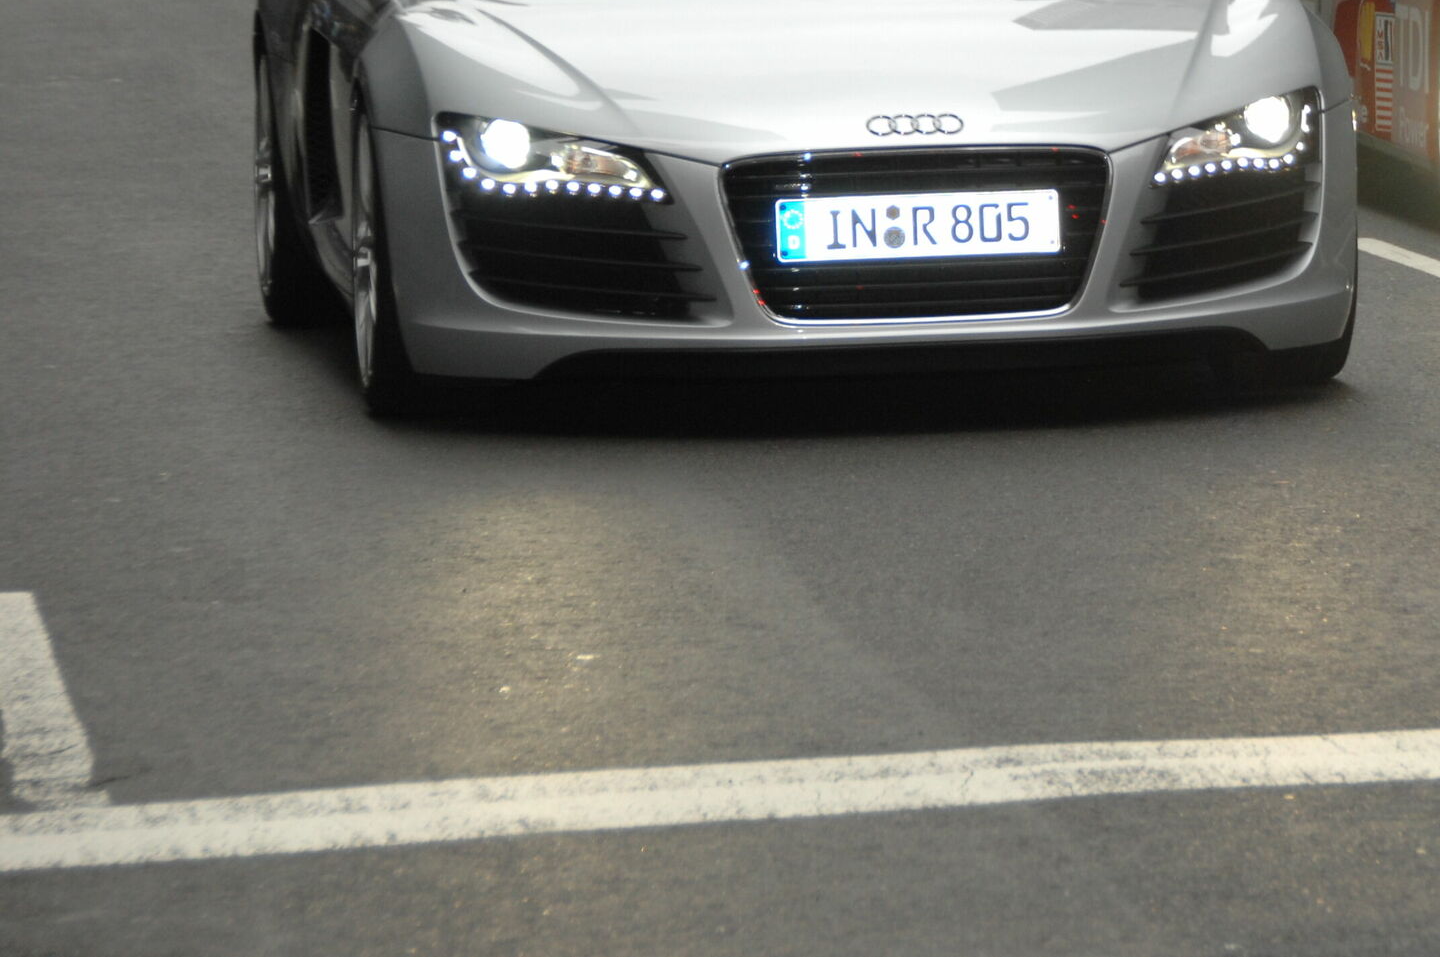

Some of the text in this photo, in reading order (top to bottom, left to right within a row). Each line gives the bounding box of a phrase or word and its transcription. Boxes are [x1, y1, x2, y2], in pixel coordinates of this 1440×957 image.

[1395, 2, 1430, 94] TDI
[827, 202, 1030, 250] IN R 805
